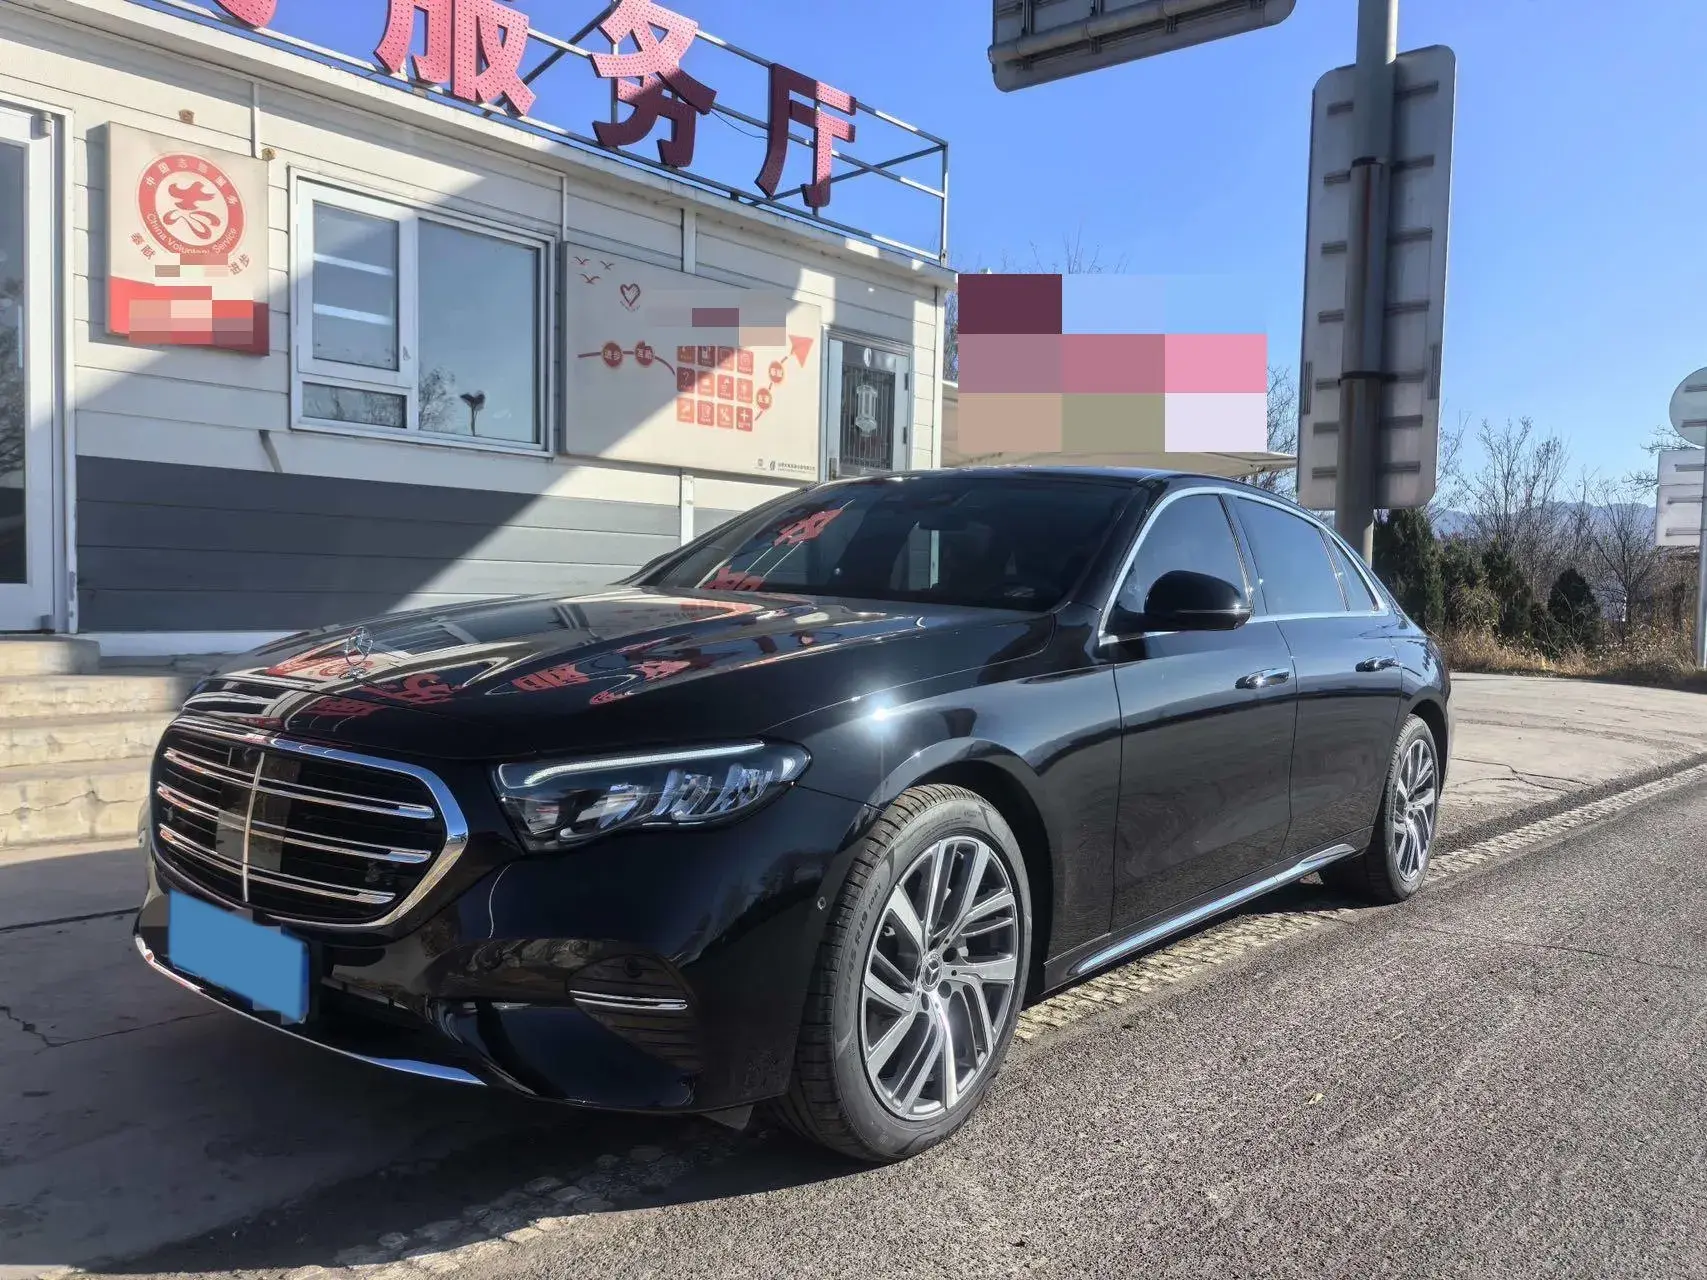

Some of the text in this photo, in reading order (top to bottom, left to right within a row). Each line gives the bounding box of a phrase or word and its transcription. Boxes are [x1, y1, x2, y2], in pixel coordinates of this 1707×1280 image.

[213, 0, 856, 208] 服务厅
[146, 213, 168, 241] China
[212, 227, 237, 254] Service
[228, 253, 250, 276] 进步
[855, 910, 868, 946] R19
